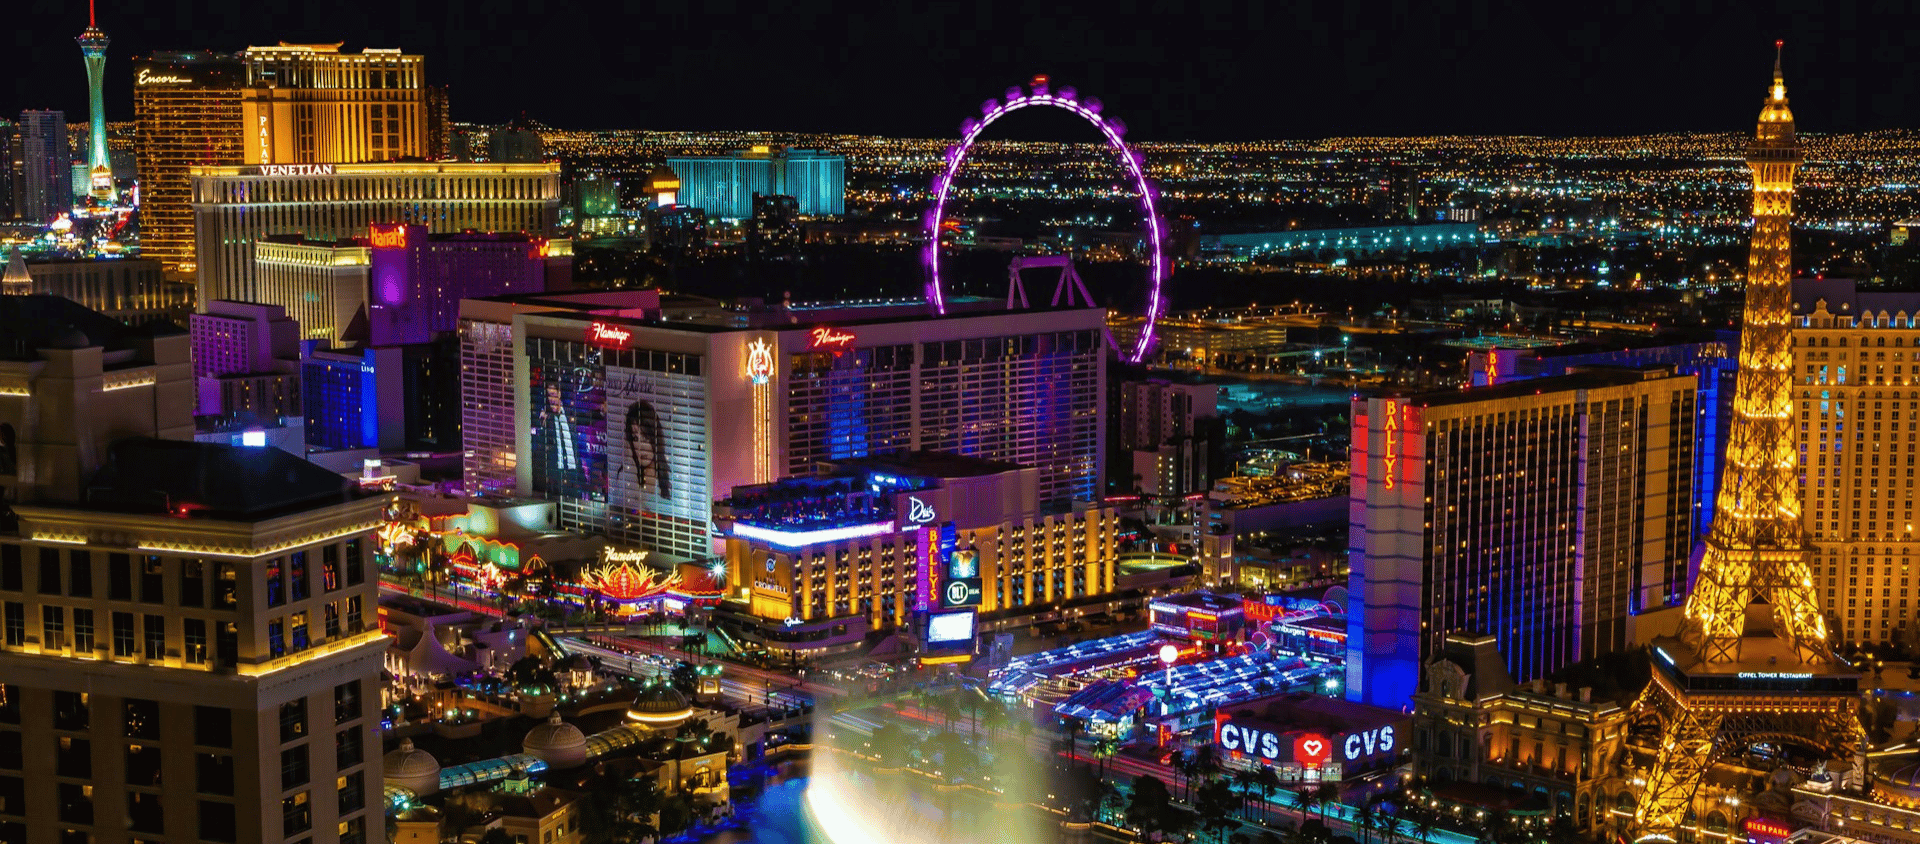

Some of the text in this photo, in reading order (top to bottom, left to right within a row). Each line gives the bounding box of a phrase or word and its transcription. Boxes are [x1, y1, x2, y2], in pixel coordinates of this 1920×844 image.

[139, 68, 192, 85] Encore
[260, 164, 332, 176] VENETIAN
[593, 322, 631, 345] Flamingo
[813, 328, 855, 347] Flamingo
[604, 546, 649, 565] Flamingo
[1221, 723, 1279, 759] CVS
[1344, 725, 1394, 760] CVS
